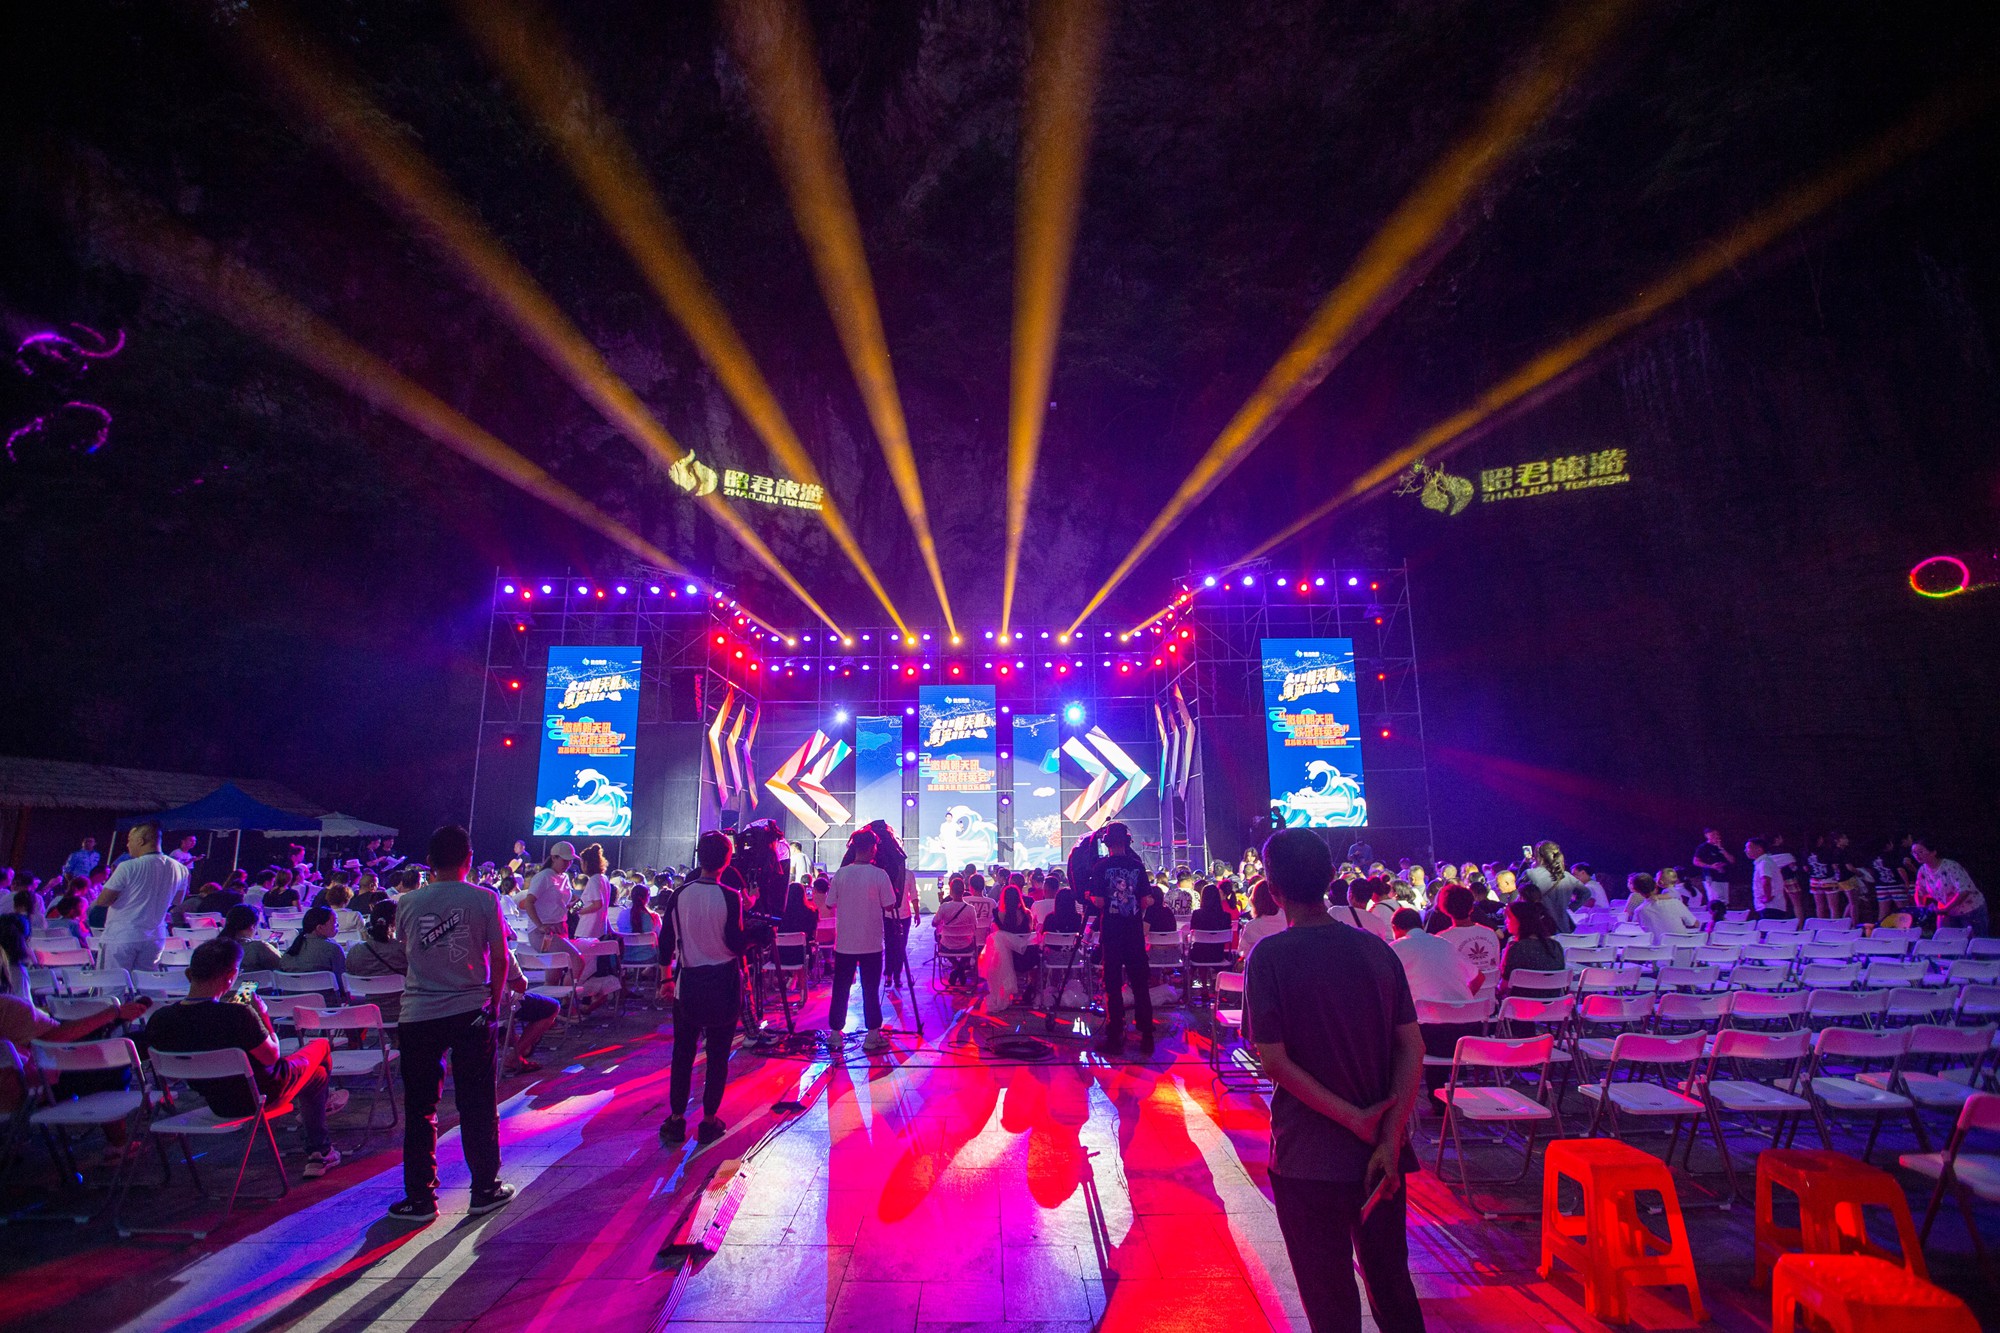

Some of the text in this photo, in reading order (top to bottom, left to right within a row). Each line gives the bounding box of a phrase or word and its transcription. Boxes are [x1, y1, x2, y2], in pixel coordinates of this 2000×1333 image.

[724, 469, 824, 503] 昭君旅游
[1481, 448, 1627, 492] 昭君旅游
[723, 487, 823, 511] ZHAOJUN TOURISM
[1481, 483, 1559, 503] ZHAOJUN
[421, 912, 461, 946] TENNIS
